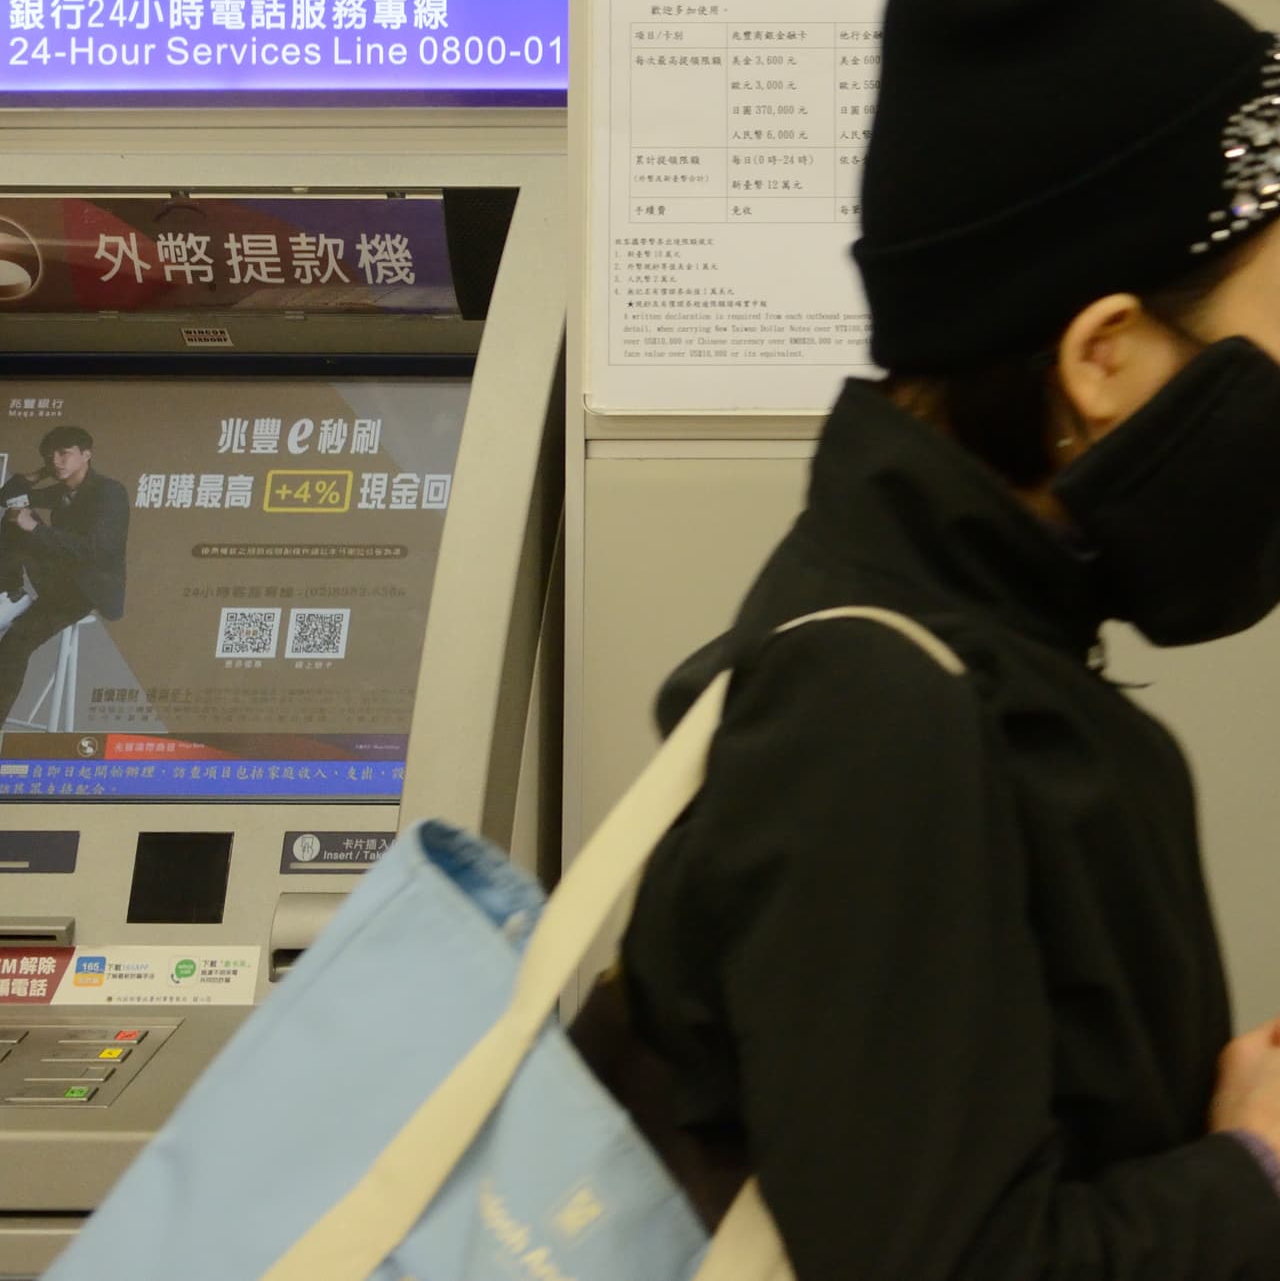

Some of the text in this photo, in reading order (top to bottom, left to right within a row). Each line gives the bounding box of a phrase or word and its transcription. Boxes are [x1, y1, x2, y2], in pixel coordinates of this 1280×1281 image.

[9, 36, 563, 66] 24-Hour Services Line 0800-01
[93, 232, 417, 286] 外幣提款機
[216, 416, 383, 457] 兆豐e秒刷
[135, 473, 255, 510] 網購最高
[274, 480, 341, 506] +4%
[20, 956, 57, 976] 解除
